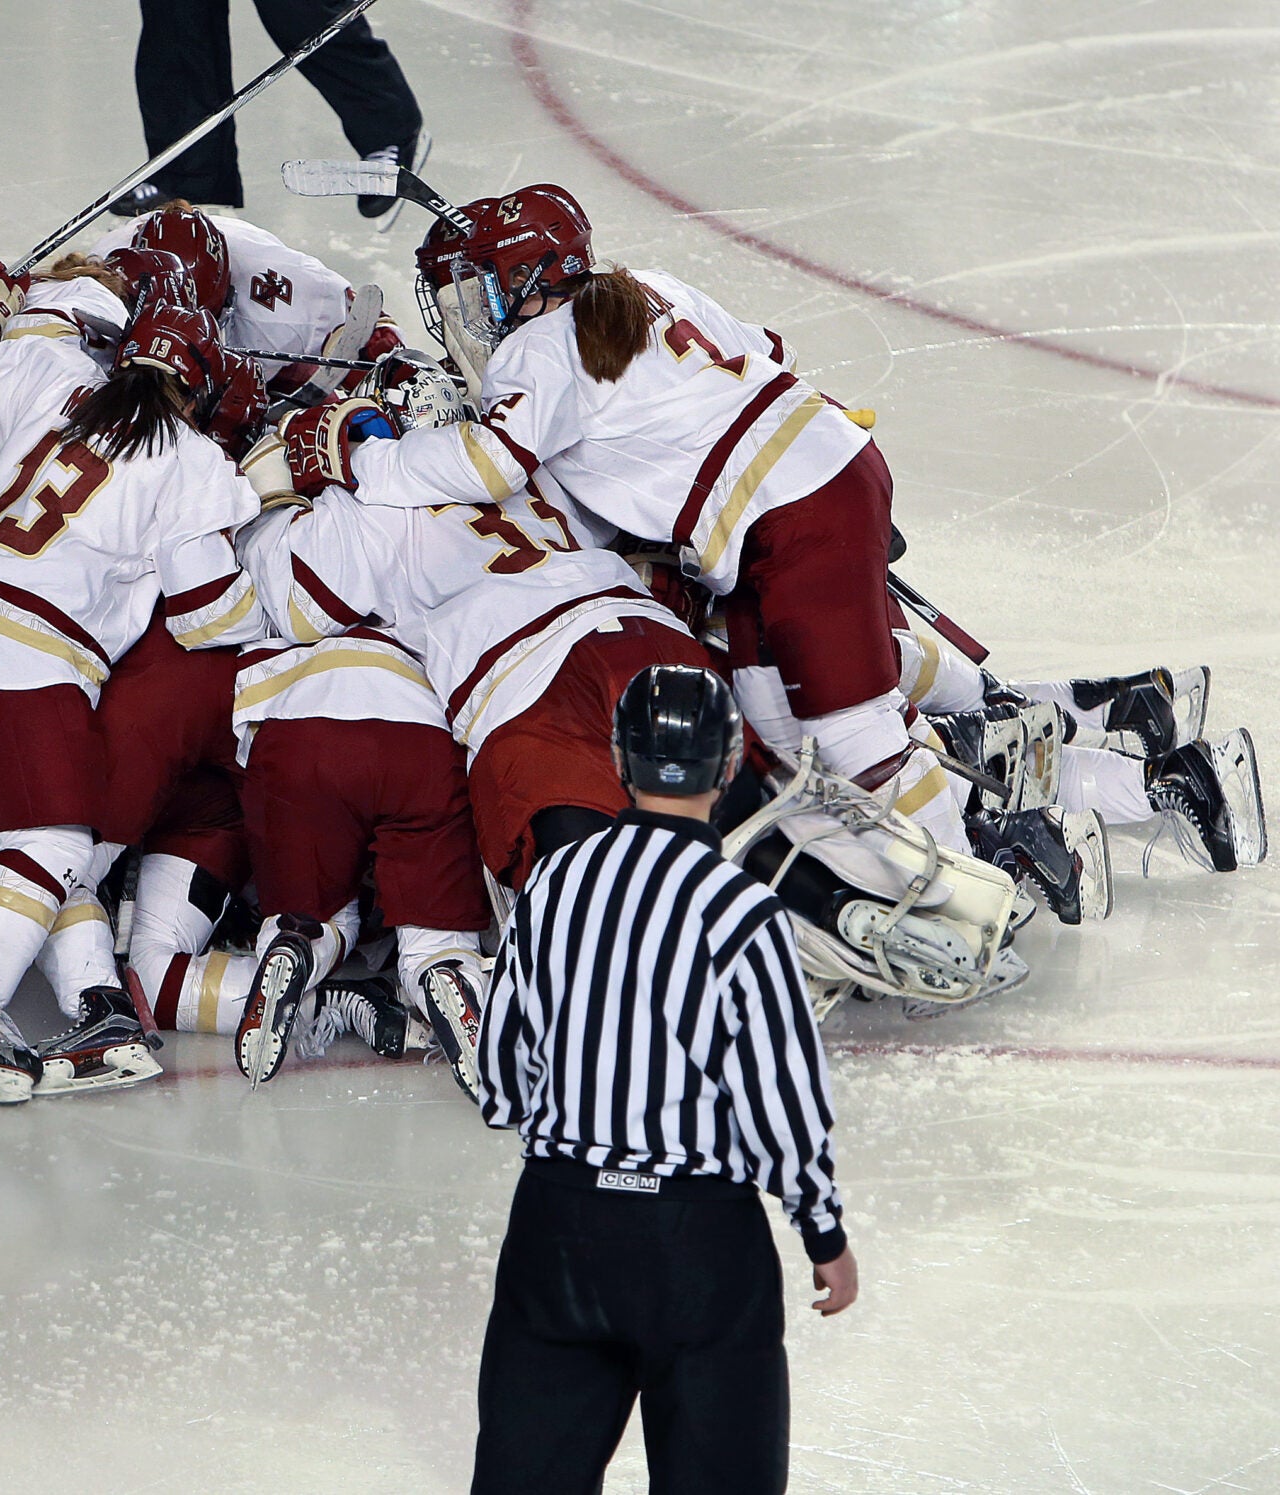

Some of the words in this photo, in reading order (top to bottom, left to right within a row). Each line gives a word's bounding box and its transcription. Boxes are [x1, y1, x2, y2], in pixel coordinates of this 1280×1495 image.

[148, 336, 172, 358] 13
[318, 405, 338, 476] UER
[601, 1172, 658, 1190] CCM
